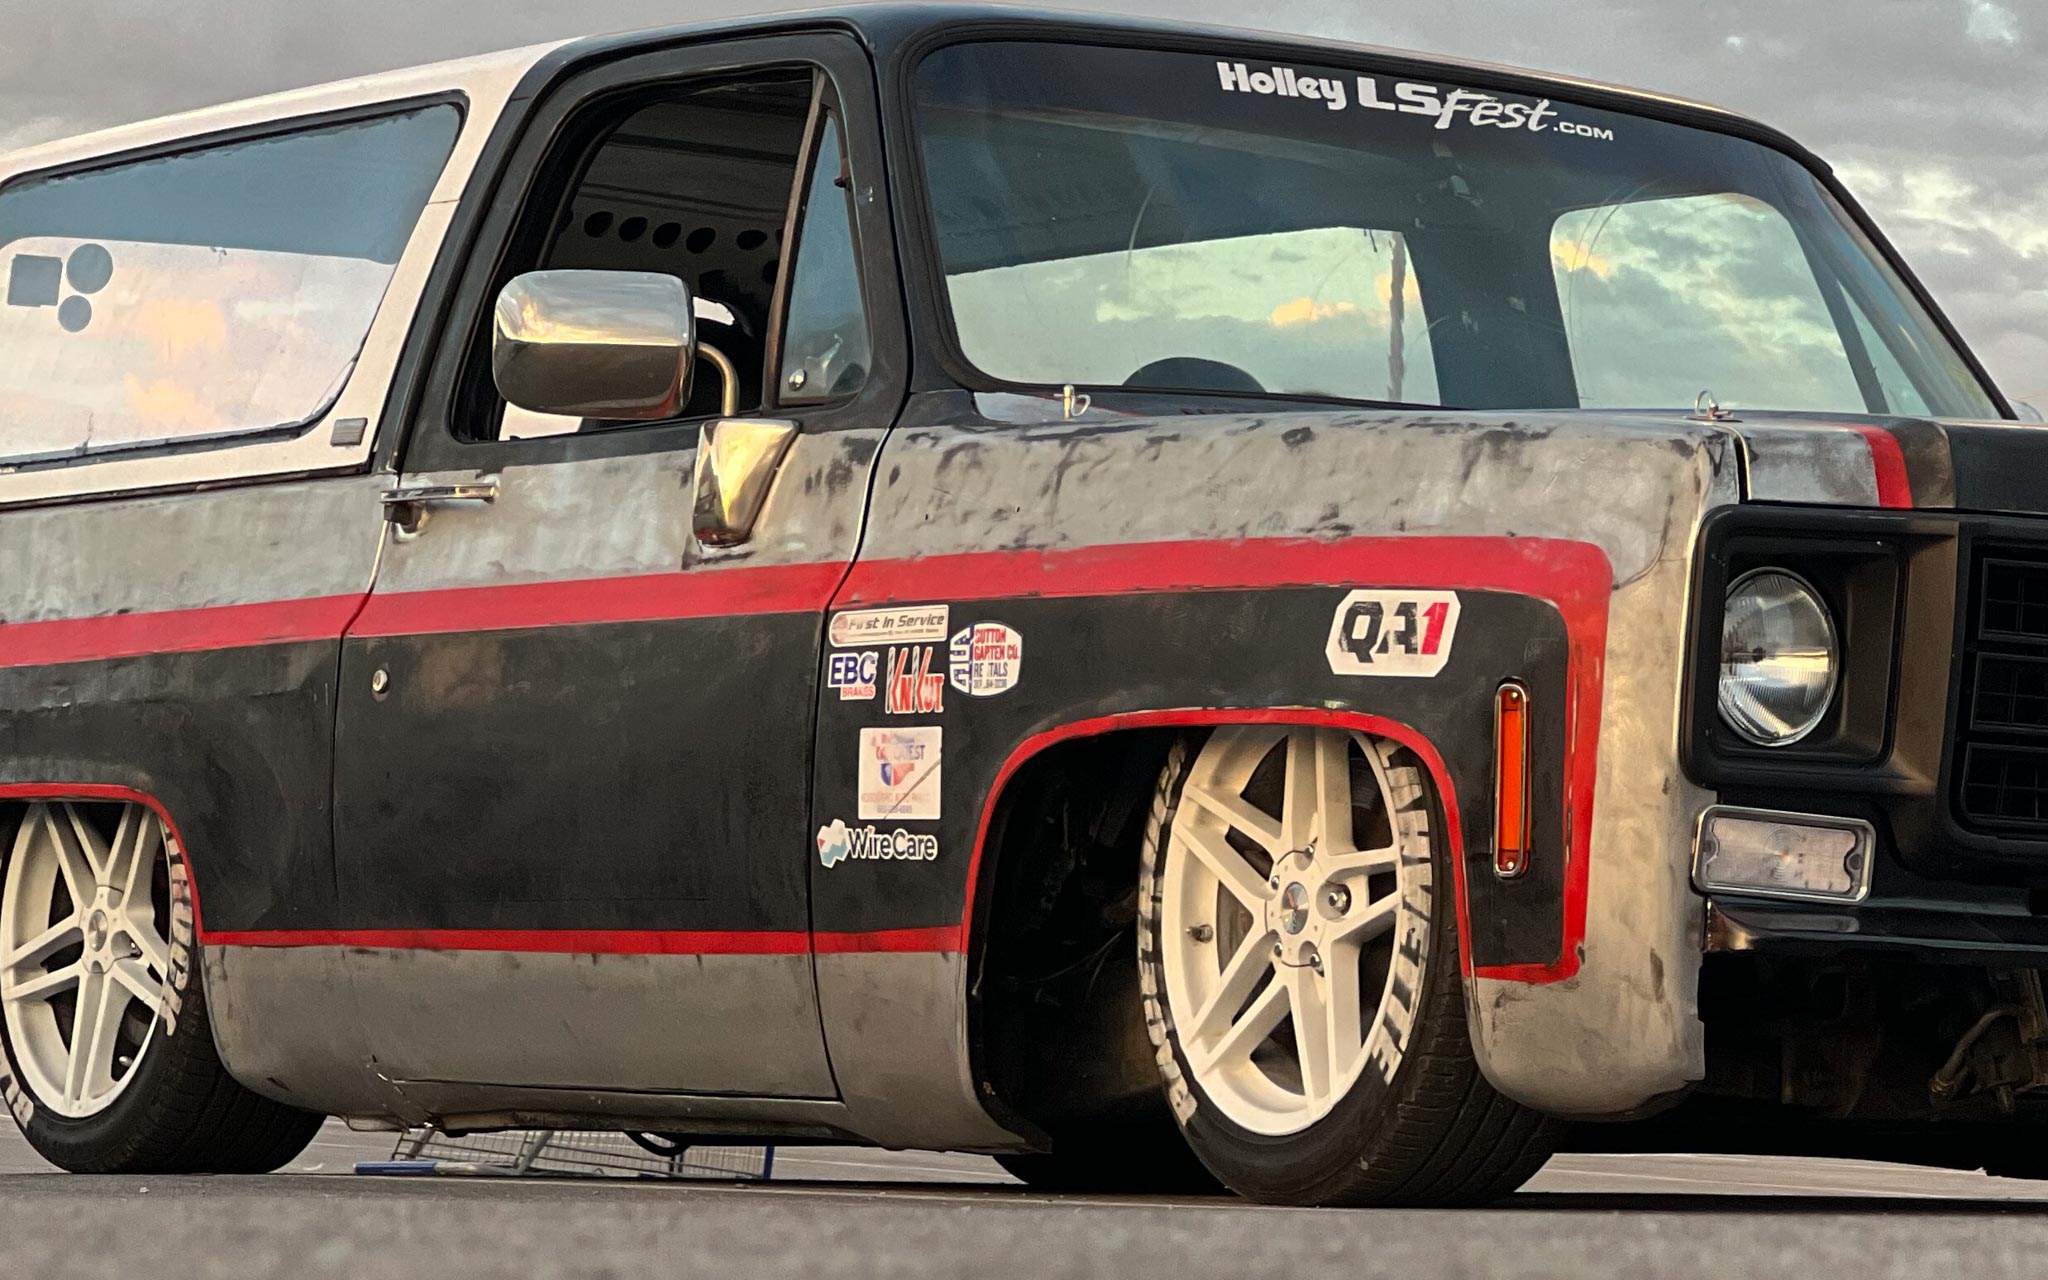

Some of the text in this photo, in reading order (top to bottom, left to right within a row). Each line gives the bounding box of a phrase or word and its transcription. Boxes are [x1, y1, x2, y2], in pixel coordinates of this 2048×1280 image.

[1216, 61, 1347, 111] Holley
[897, 613, 945, 627] Service
[1338, 600, 1450, 664] QA1
[830, 654, 876, 685] EBC
[974, 661, 1008, 678] RETALS
[841, 686, 874, 698] BRAKES
[848, 827, 936, 857] WireCare
